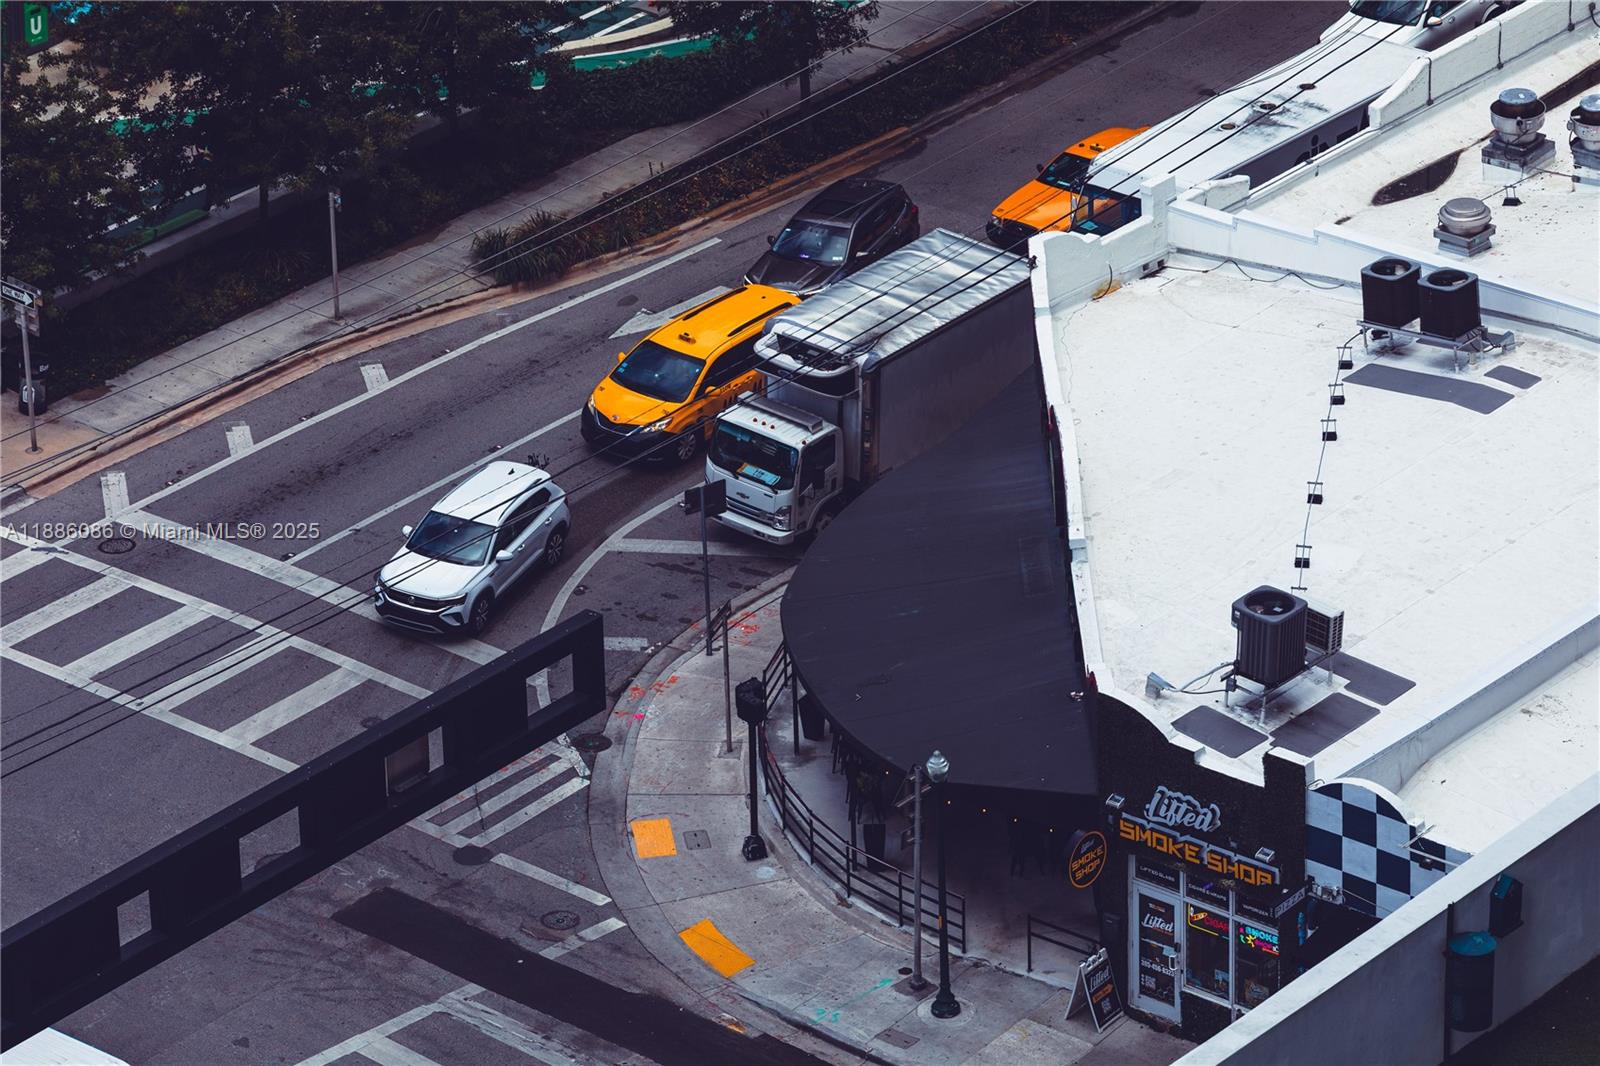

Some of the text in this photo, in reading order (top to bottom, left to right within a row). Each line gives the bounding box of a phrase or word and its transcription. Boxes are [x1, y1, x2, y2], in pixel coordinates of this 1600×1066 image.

[30, 15, 42, 35] U
[1144, 789, 1219, 832] Lifted
[1071, 844, 1104, 872] SMOKE
[1119, 817, 1273, 886] SMOKE SHOP
[1075, 858, 1100, 881] SHOP
[1141, 913, 1174, 932] Lifted
[1245, 926, 1279, 944] SMOKE
